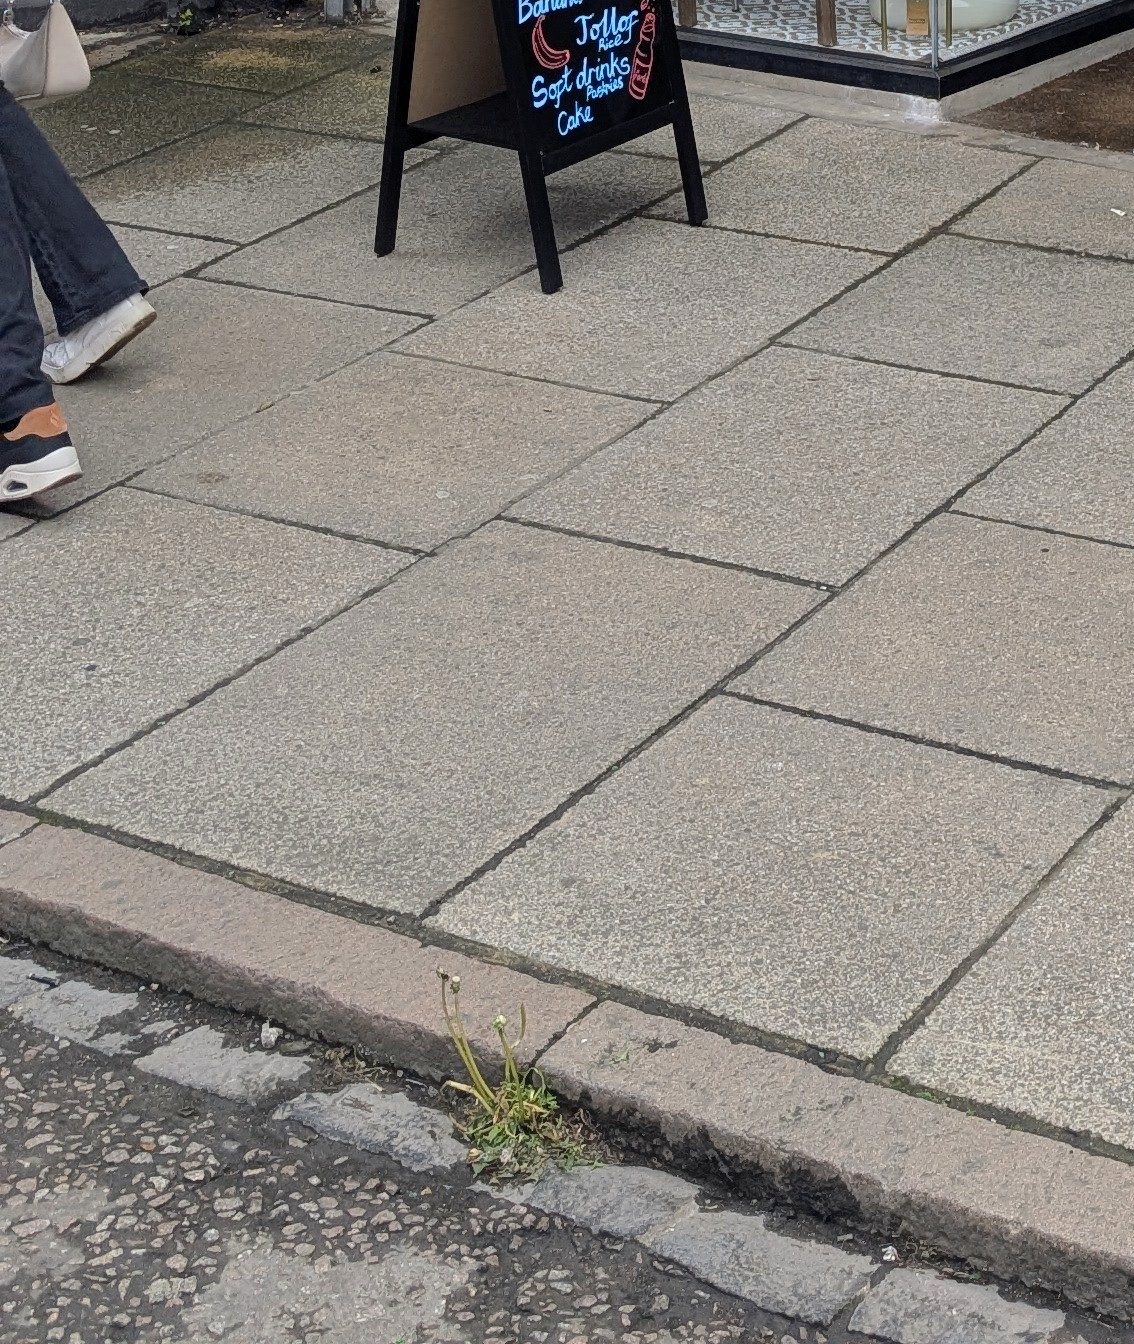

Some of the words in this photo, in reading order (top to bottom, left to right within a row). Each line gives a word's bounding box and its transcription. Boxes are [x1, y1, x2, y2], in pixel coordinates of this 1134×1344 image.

[574, 6, 639, 46] Jollof
[598, 33, 624, 52] Rice
[531, 65, 574, 109] Soft
[576, 52, 631, 90] drinks
[586, 75, 624, 102] Pastries
[557, 101, 594, 136] Cake
